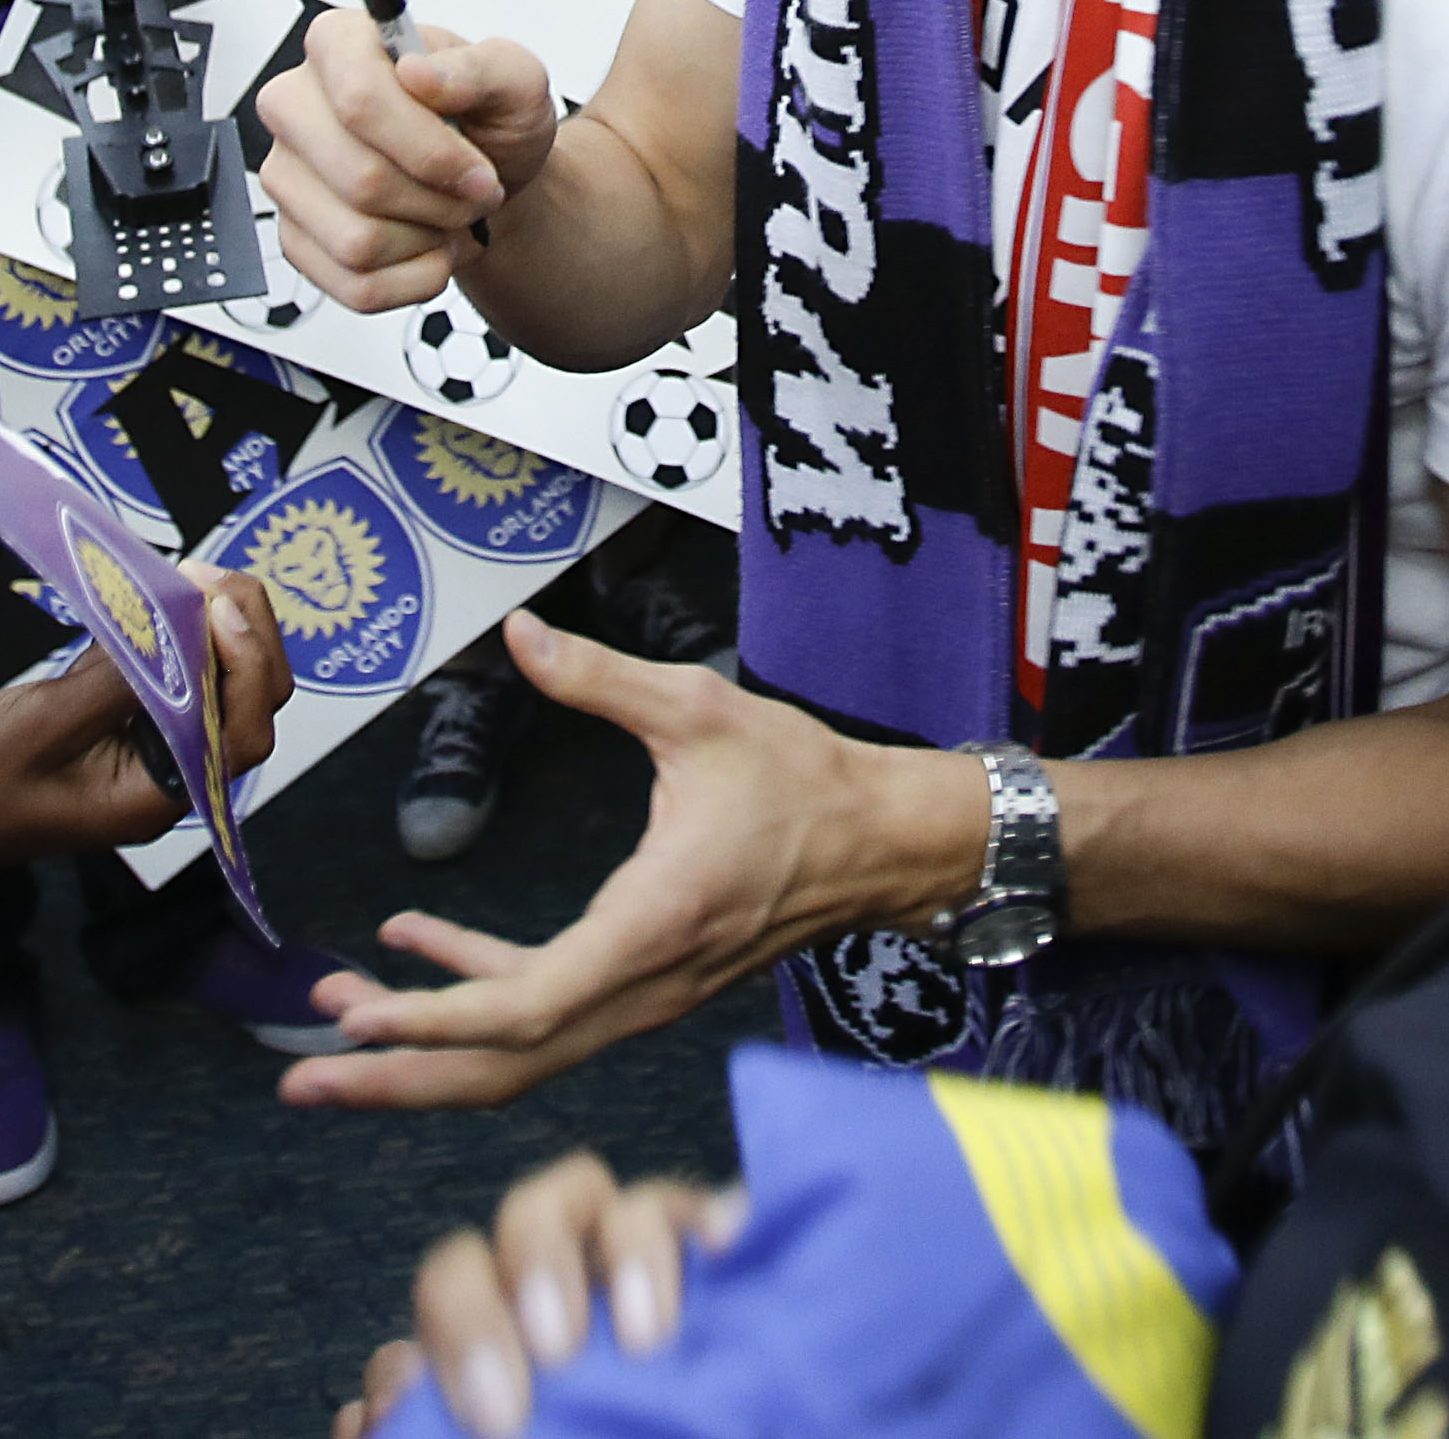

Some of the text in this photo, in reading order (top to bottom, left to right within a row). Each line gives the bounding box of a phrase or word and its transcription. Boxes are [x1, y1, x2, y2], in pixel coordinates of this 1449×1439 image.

[527, 498, 575, 542] CITY
[314, 593, 419, 680] ORLANDO
[355, 630, 405, 674] CITY
